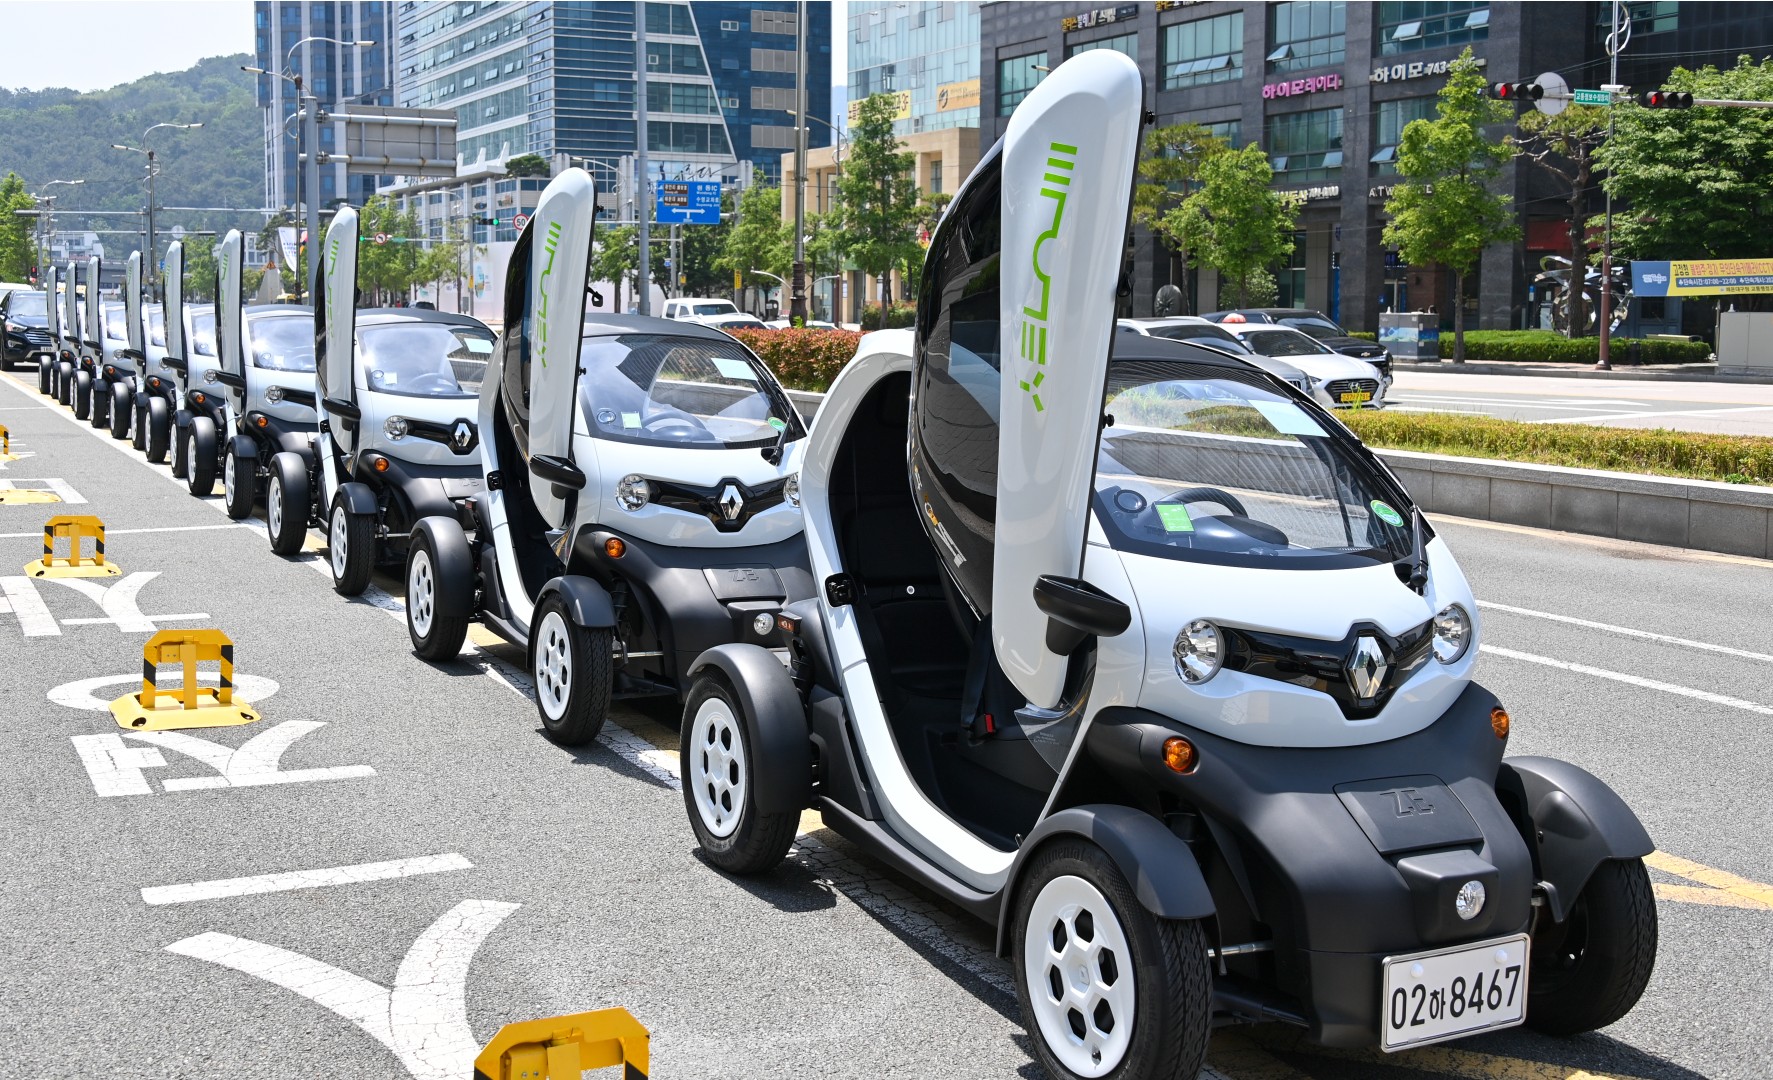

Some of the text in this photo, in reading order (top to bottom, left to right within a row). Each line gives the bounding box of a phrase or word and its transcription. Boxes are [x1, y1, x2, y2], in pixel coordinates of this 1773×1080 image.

[1374, 62, 1424, 83] 하이모
[1262, 74, 1341, 99] 하이모레이디
[516, 218, 526, 227] 50
[1391, 965, 1521, 1029] 02하8467
